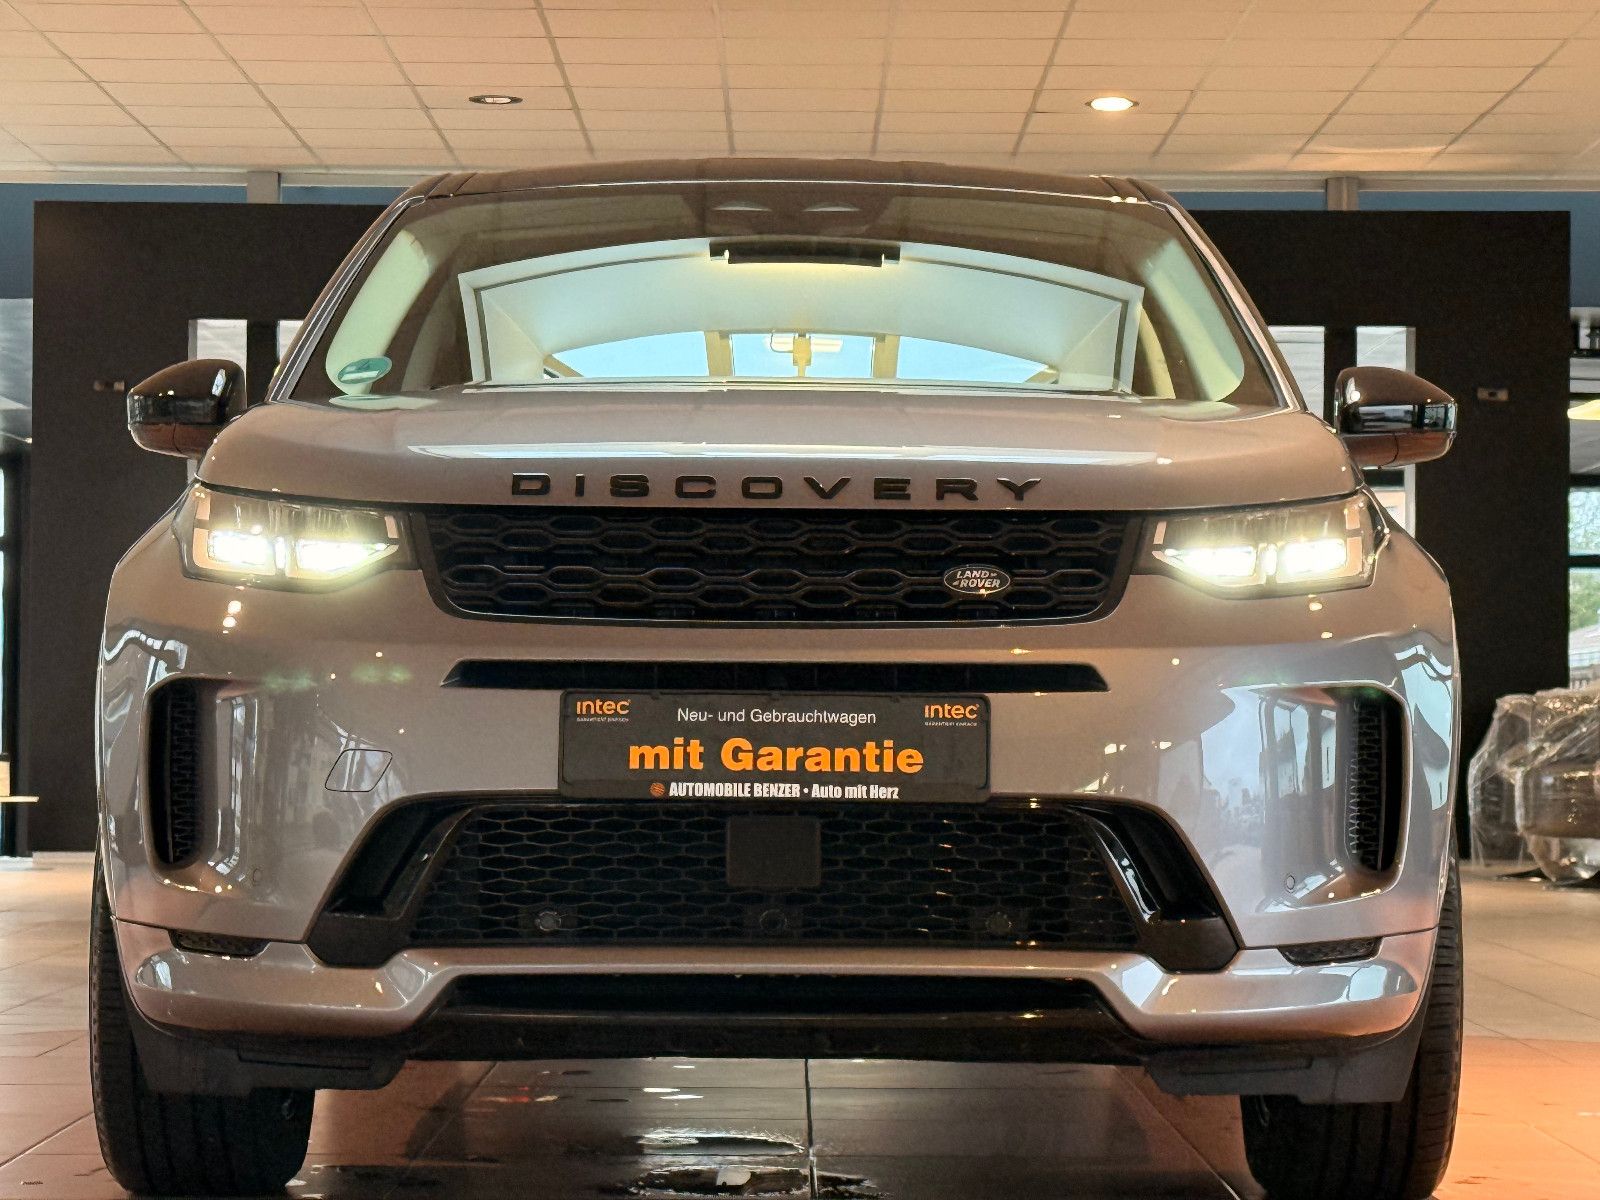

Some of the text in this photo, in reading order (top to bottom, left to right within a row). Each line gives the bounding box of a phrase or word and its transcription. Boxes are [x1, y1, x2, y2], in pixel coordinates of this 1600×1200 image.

[510, 473, 1042, 501] DISCOVERY
[956, 570, 989, 579] LAND
[959, 578, 1001, 588] ROVER
[576, 699, 631, 715] intec
[924, 703, 979, 719] intec
[677, 707, 877, 727] Neu- und Gebrauchtwagen
[629, 736, 924, 774] mit Garantie
[669, 781, 900, 799] AUTOMOBILE BENZER Auto mit Herz
